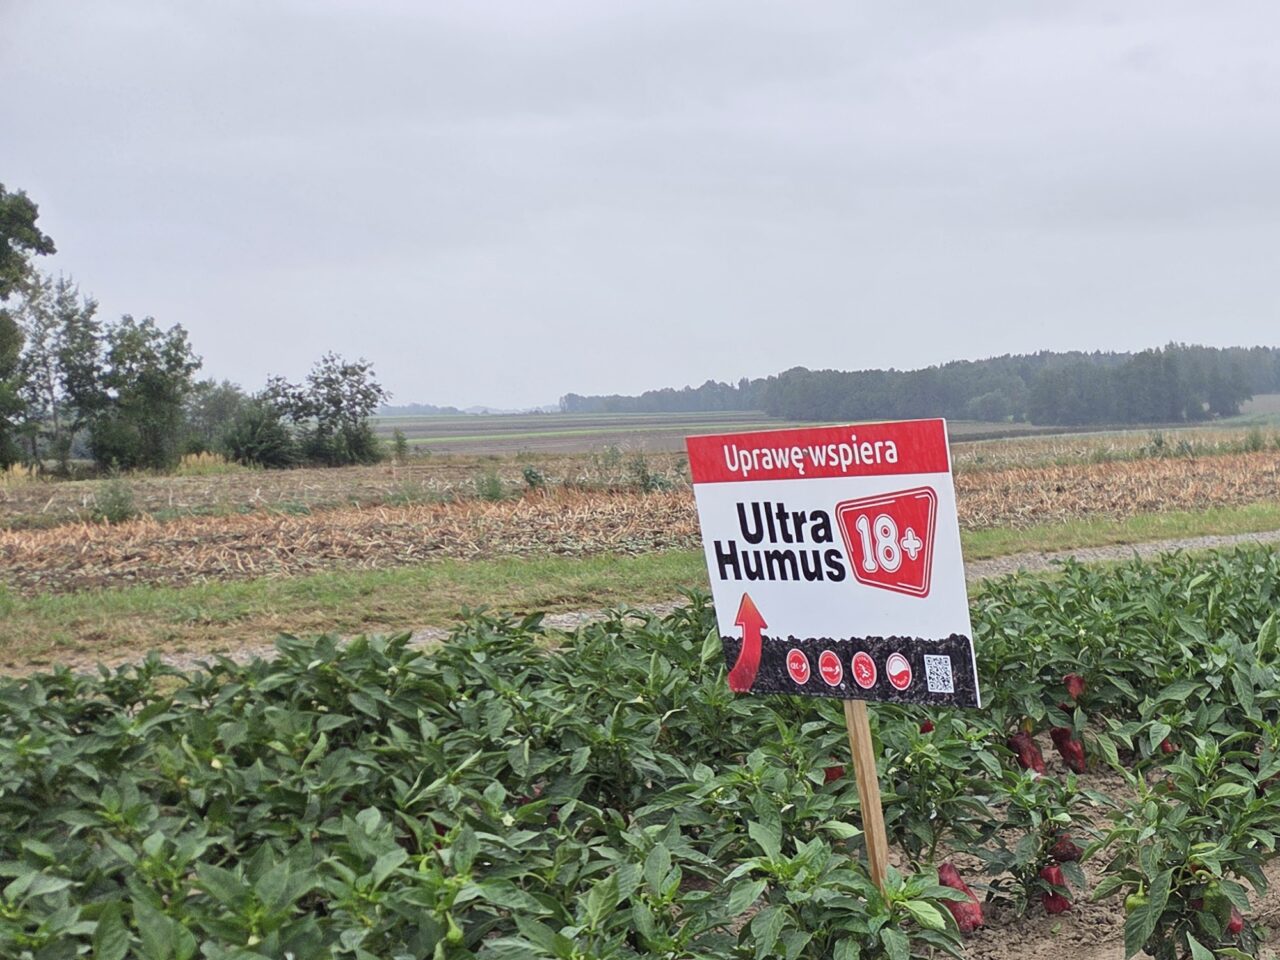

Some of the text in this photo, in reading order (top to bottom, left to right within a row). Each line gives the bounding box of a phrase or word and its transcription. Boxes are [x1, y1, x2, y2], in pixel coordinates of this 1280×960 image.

[723, 435, 898, 477] Uprawę wspiera
[736, 501, 833, 545] Ultra
[855, 513, 922, 573] 18+
[713, 540, 847, 583] Humus
